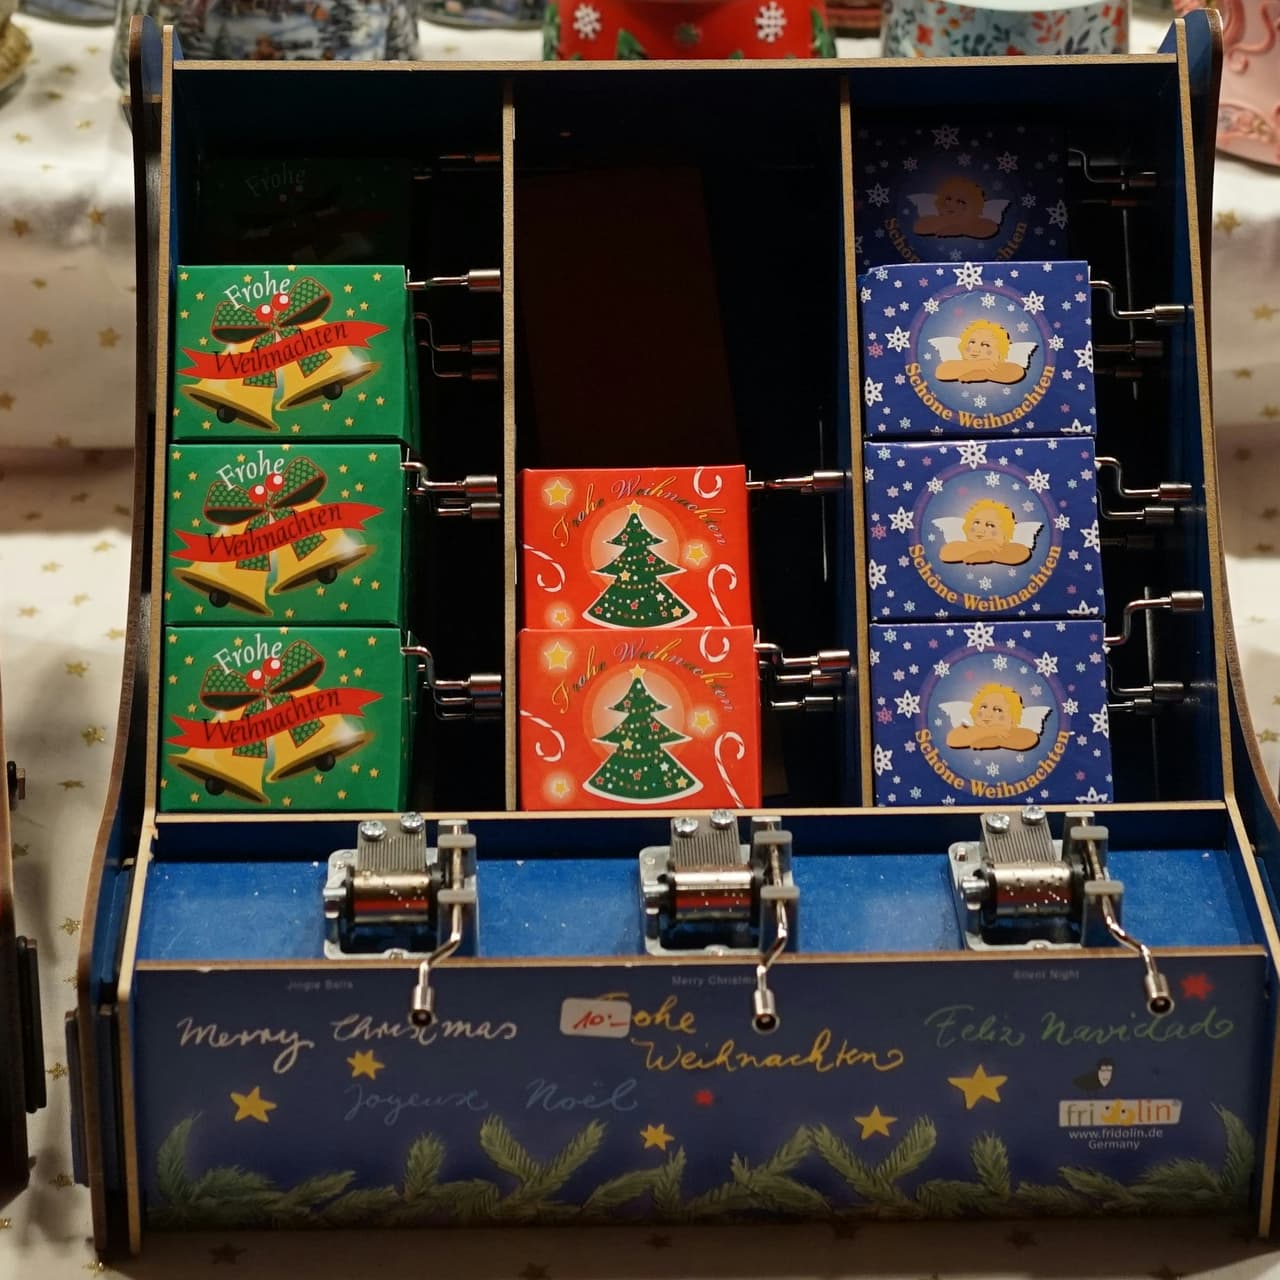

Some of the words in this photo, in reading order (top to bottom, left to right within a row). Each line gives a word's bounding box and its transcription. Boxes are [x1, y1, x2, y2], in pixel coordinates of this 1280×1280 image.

[223, 270, 291, 310] Frohe
[213, 321, 348, 377] Weihnachten
[904, 362, 953, 421] Schöne
[957, 364, 1055, 430] Weihnachten
[216, 450, 285, 491] Frohe
[206, 502, 342, 558] Weihnachten
[551, 484, 605, 548] Frohe
[611, 475, 728, 546] Weihnachten
[908, 542, 958, 604] Schöne
[962, 545, 1062, 612] Weihnachten
[212, 632, 283, 674] Frohe
[551, 645, 607, 715] Frohe
[613, 637, 736, 713] Weihnachten
[202, 687, 340, 744] Weihnachten
[914, 726, 965, 790] Schöne
[970, 730, 1070, 799] Weihnachten
[176, 1017, 315, 1074] Merry
[630, 1028, 904, 1072] Weihnachten
[925, 1005, 1025, 1049] Feliz
[1040, 1004, 1235, 1044] Navidad
[343, 1083, 490, 1124] Joyeux
[1069, 1127, 1163, 1139] www.fridolin.de
[1088, 1139, 1141, 1151] Germany
